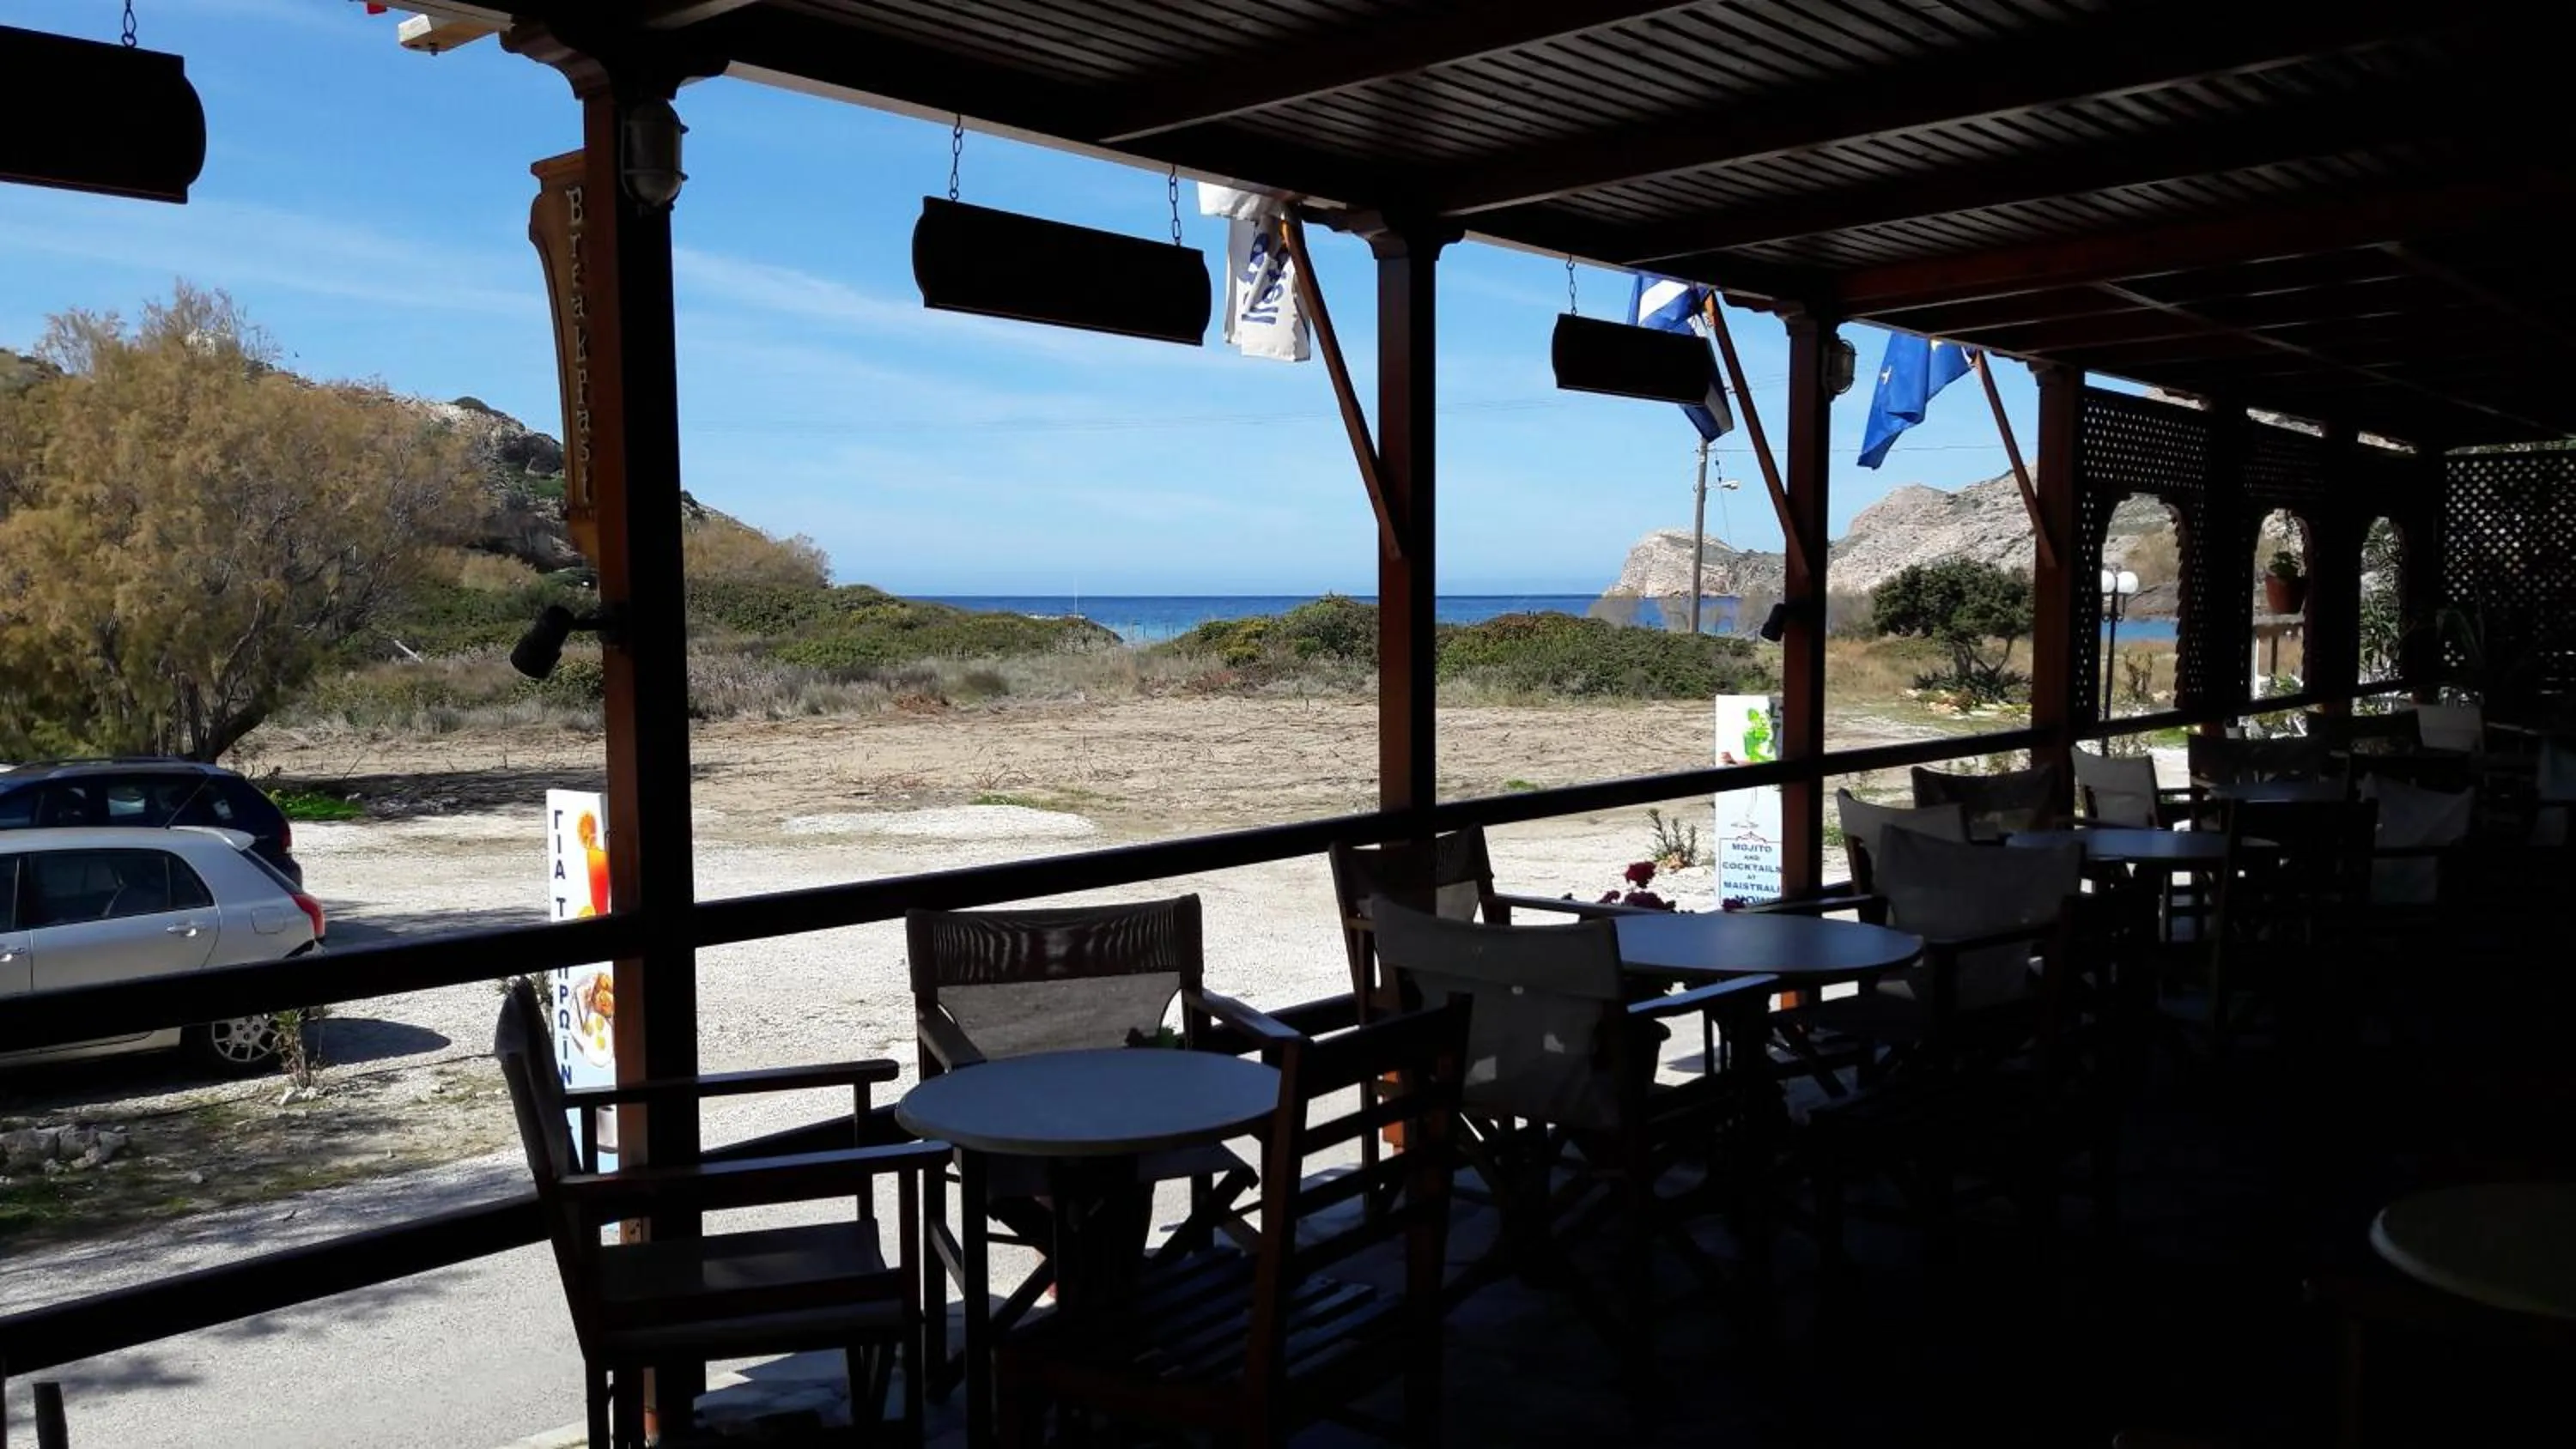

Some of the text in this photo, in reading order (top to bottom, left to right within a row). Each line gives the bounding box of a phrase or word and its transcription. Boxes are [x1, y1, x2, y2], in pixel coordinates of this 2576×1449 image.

[1732, 843, 1772, 852] MOJITO
[1722, 862, 1782, 873] COCKTAILS
[1724, 882, 1780, 893] MAISTRALI
